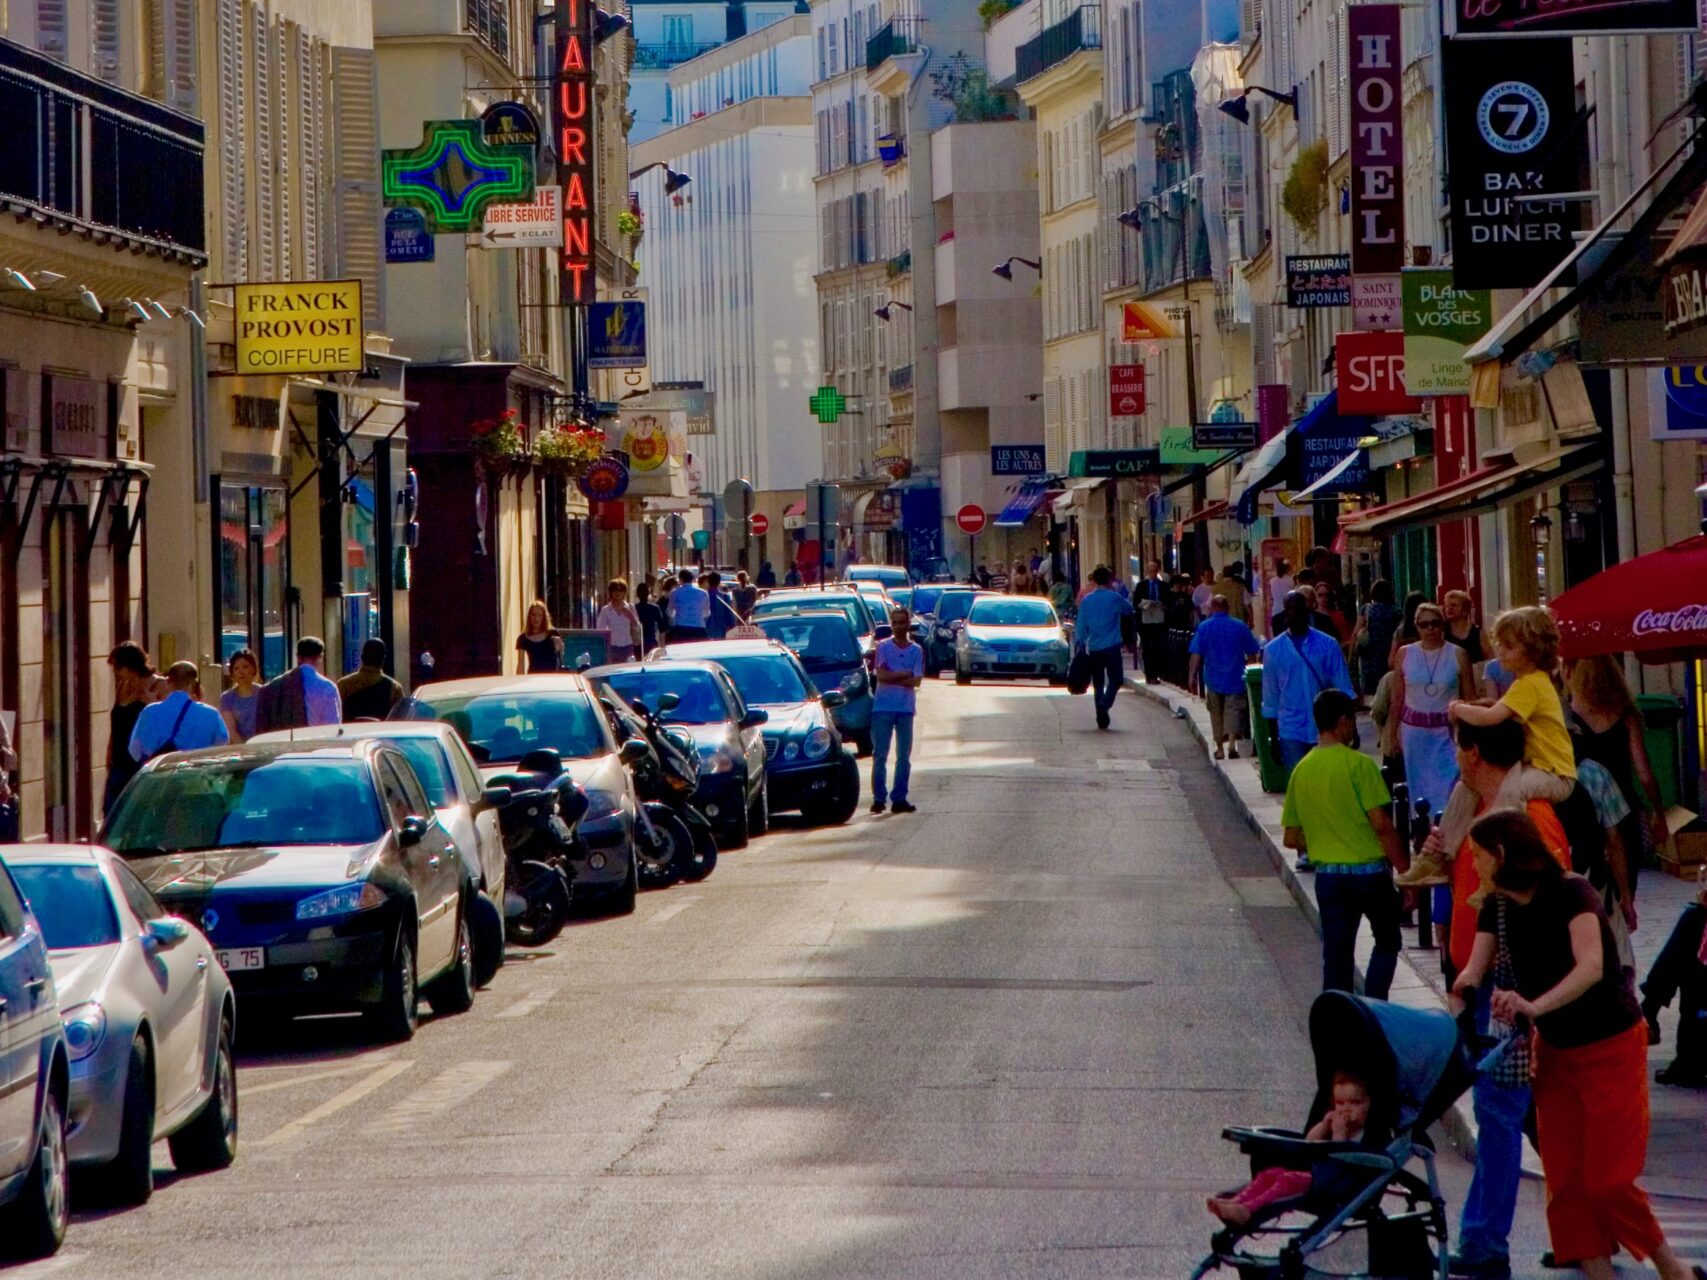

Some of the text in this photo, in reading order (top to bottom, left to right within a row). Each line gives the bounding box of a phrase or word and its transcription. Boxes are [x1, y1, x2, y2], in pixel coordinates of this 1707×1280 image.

[1497, 103, 1529, 136] 7
[1357, 33, 1396, 246] HOTEL
[486, 208, 556, 224] LIBRE SERVICE
[521, 229, 556, 238] ECLAT
[1471, 222, 1563, 244] DINER
[1362, 282, 1394, 294] SAINT
[246, 292, 350, 314] FRANCK
[1296, 291, 1350, 305] JAPONAIS
[1353, 296, 1402, 311] DOMINIQU
[1437, 300, 1457, 310] DES
[1415, 310, 1482, 327] VOSGES
[241, 317, 357, 339] PROVOST
[247, 347, 350, 366] COIFFURE
[1348, 354, 1405, 393] SFR
[1431, 363, 1463, 376] Linge
[1111, 383, 1144, 394] BRASSERIE
[1418, 375, 1472, 388] de Maiso
[998, 450, 1041, 460] LES UNS &
[996, 460, 1042, 471] LES AUTRES
[240, 950, 260, 967] 75
